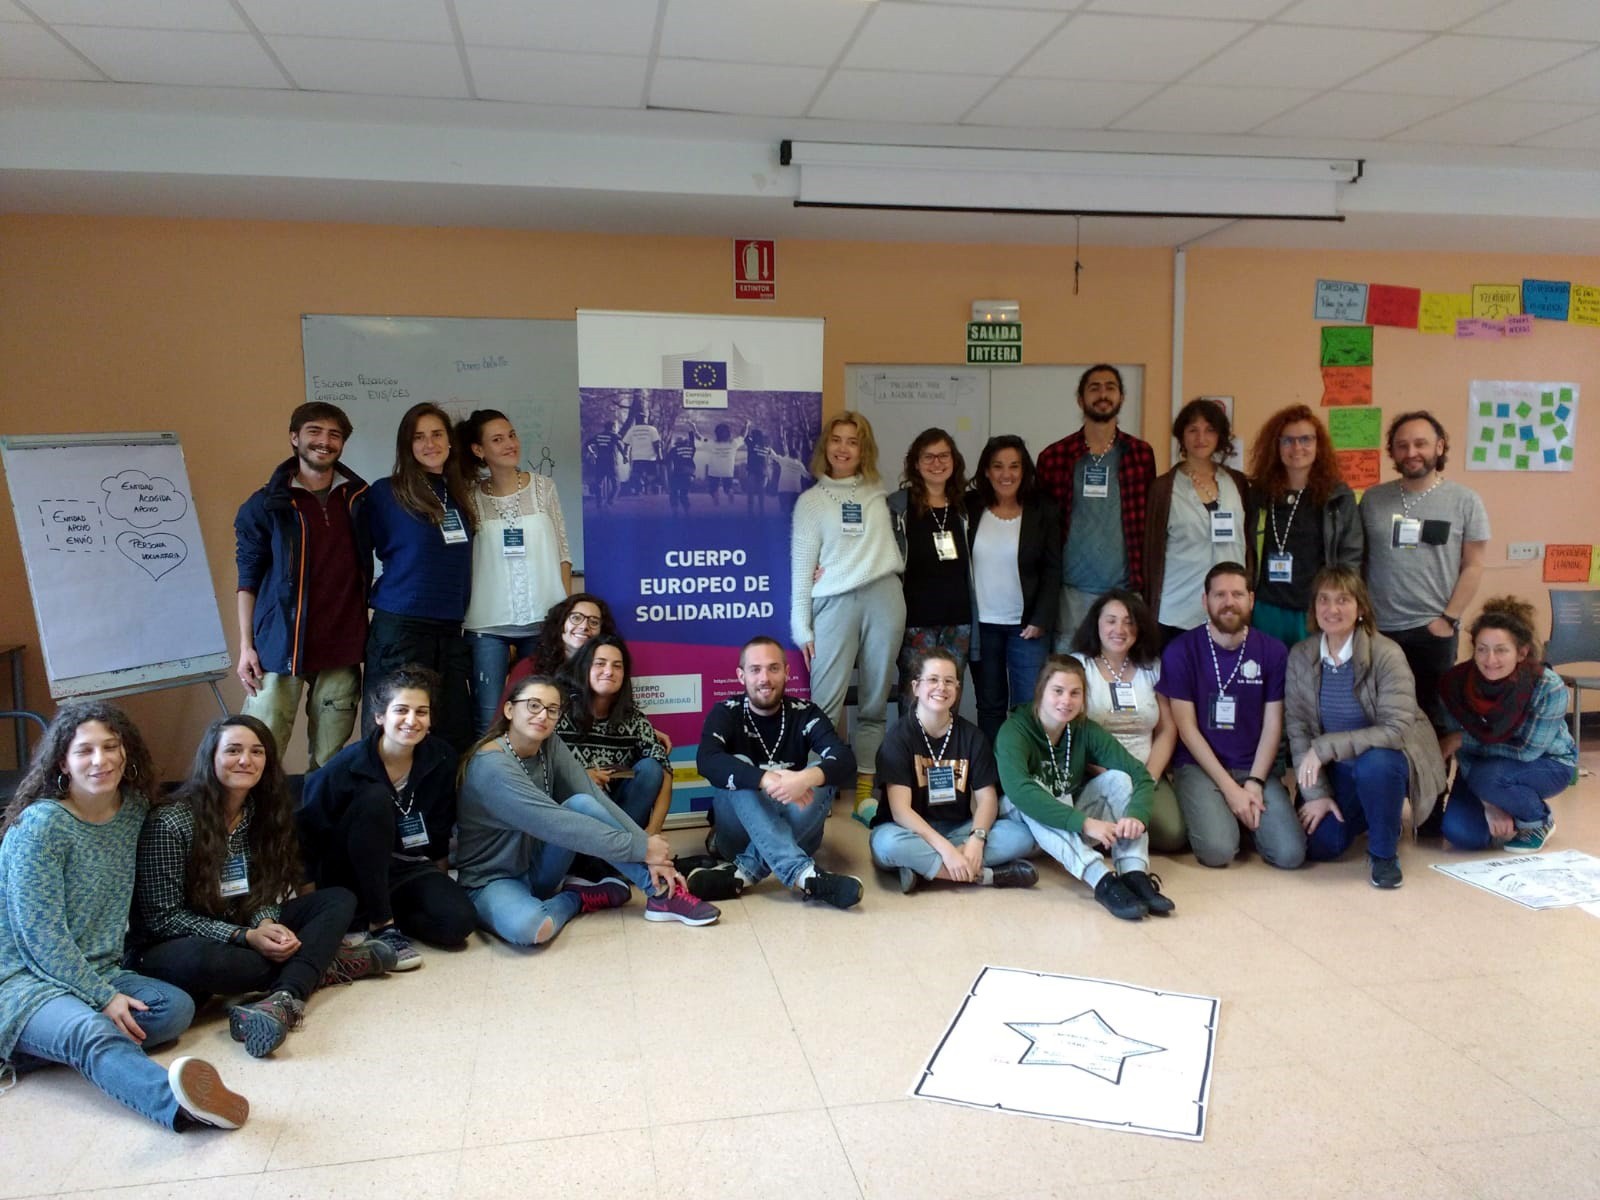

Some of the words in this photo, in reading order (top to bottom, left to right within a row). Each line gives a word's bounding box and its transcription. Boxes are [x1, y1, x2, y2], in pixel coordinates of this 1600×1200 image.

[971, 326, 1018, 339] SALIDA
[970, 346, 1018, 361] IRTEERA
[133, 505, 158, 513] APOYO
[67, 524, 91, 533] APOYO
[665, 549, 747, 568] CUERPO
[640, 576, 737, 595] EUROPEO
[744, 575, 770, 592] DE
[636, 601, 774, 622] SOLIDARIDAD
[643, 697, 692, 705] SOLIDARIDAD
